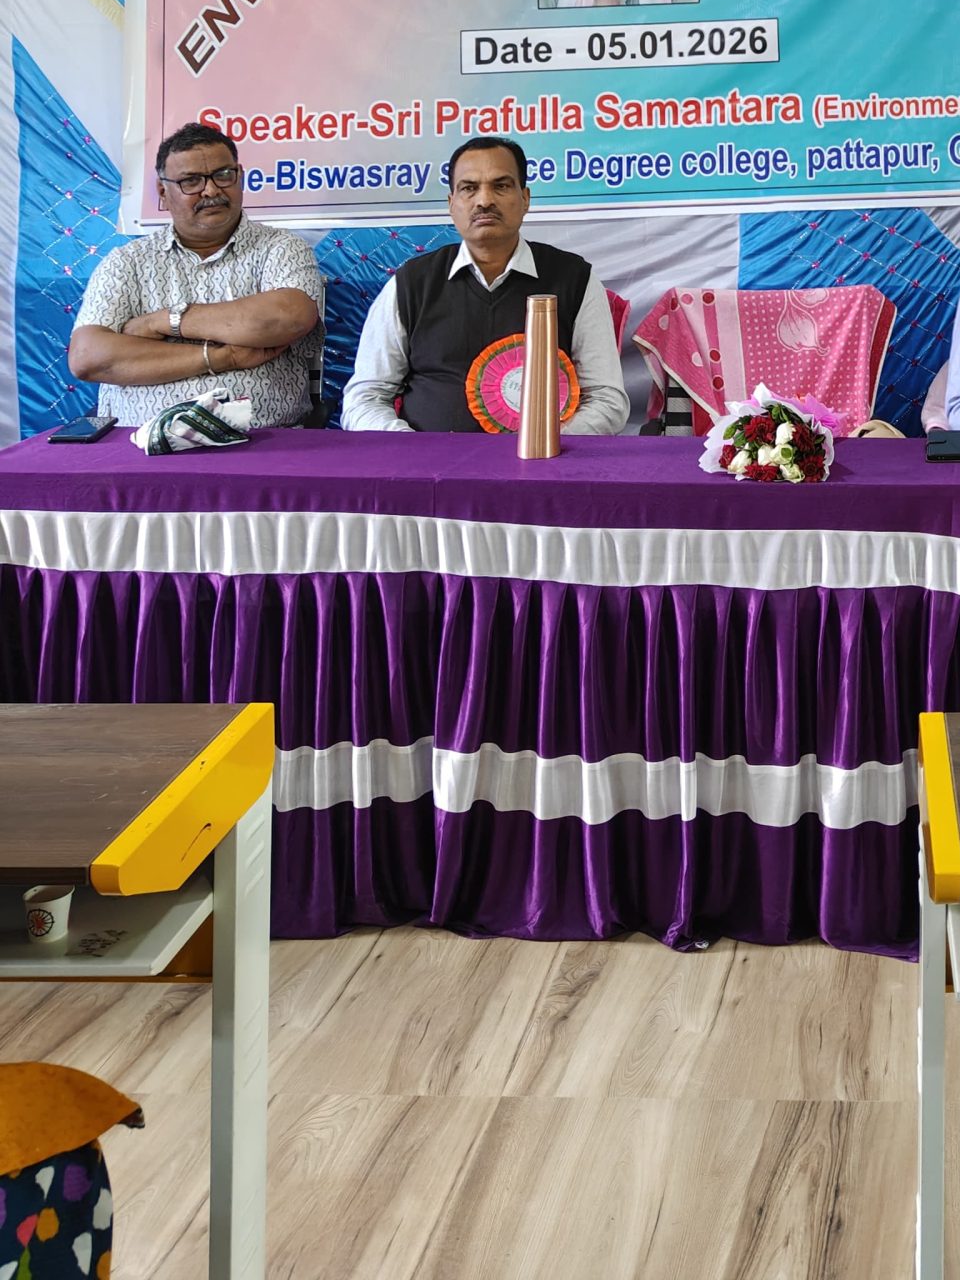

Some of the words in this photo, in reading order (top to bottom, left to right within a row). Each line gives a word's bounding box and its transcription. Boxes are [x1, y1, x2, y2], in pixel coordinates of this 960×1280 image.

[474, 36, 552, 65] Date
[586, 25, 768, 61] 05.01.2026
[199, 101, 421, 143] Speaker-Sri
[435, 96, 583, 135] Prafulla
[596, 90, 802, 129] Samantara
[565, 149, 672, 186] Degree
[681, 143, 797, 180] college,
[807, 138, 939, 178] pattapur,
